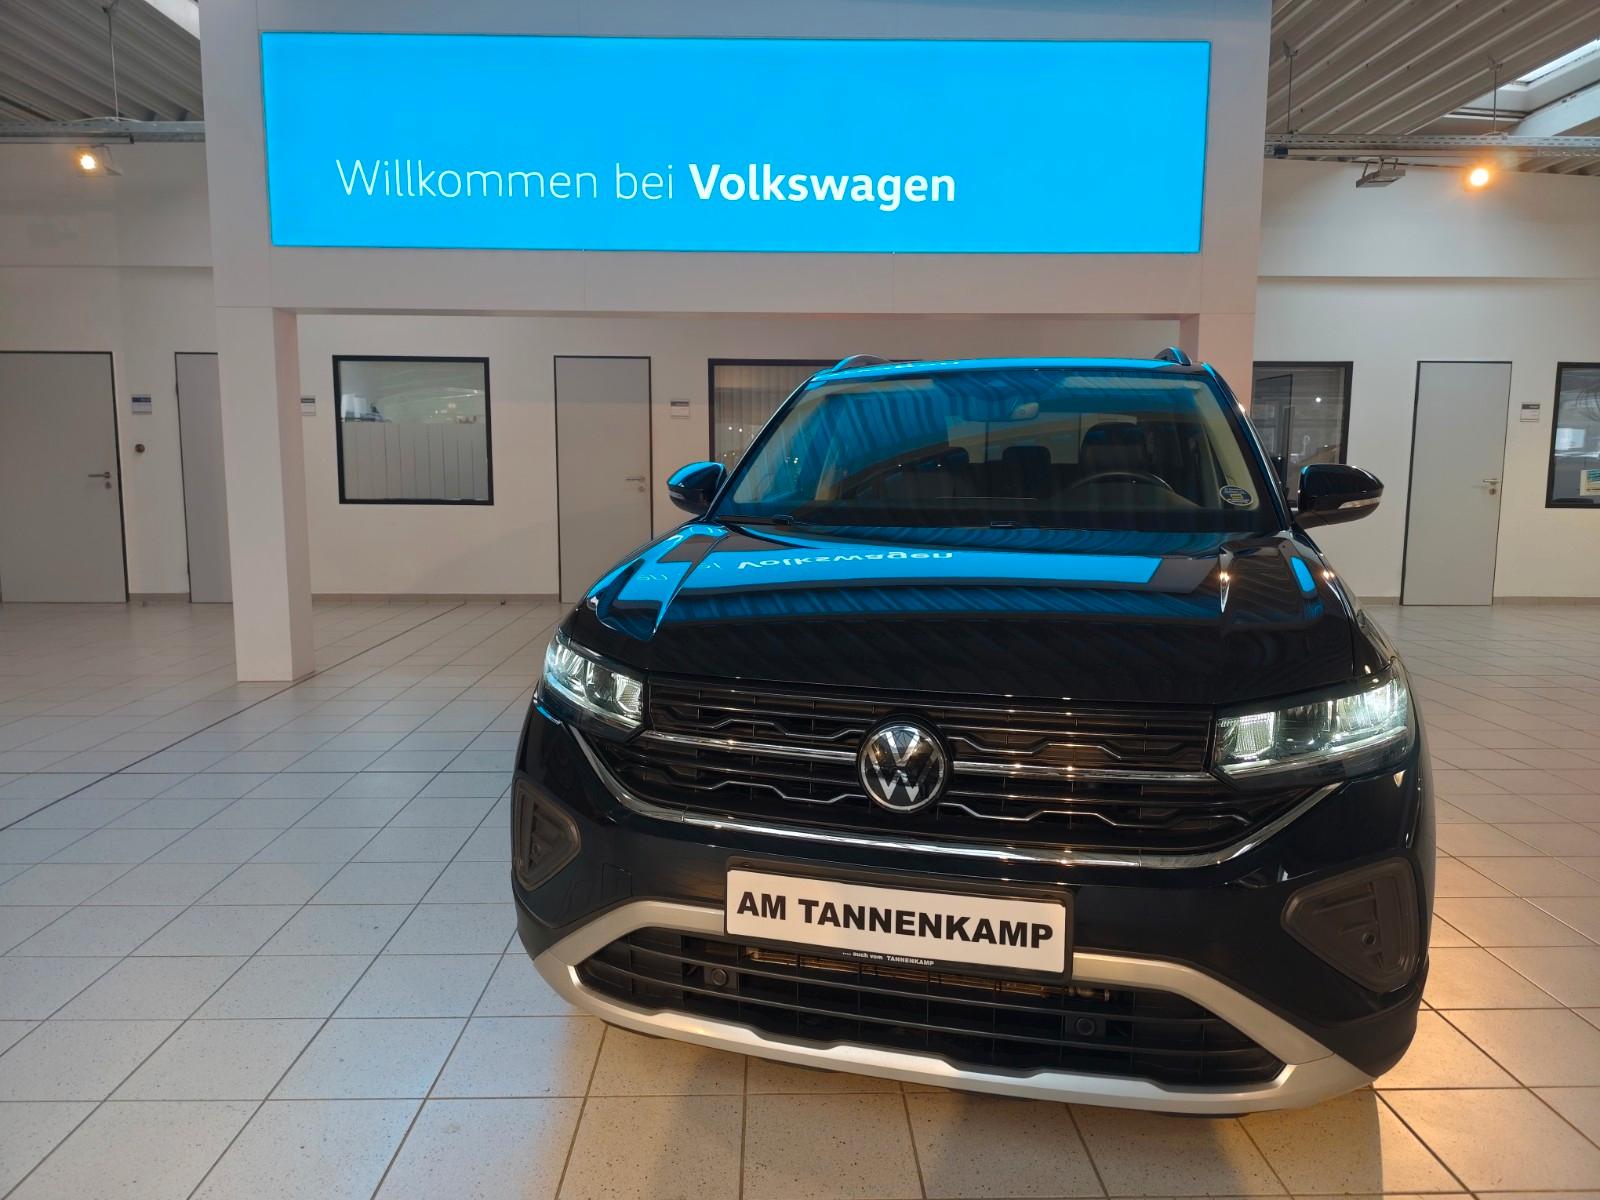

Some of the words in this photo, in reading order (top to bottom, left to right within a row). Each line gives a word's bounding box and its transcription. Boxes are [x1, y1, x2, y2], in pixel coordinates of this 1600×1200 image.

[335, 158, 598, 199] Willkommen
[615, 162, 674, 200] bei
[687, 163, 956, 212] Volkswagen
[736, 891, 787, 921] AM
[797, 897, 1054, 949] TANNENKAMP
[886, 954, 935, 966] TANNENKAMP
